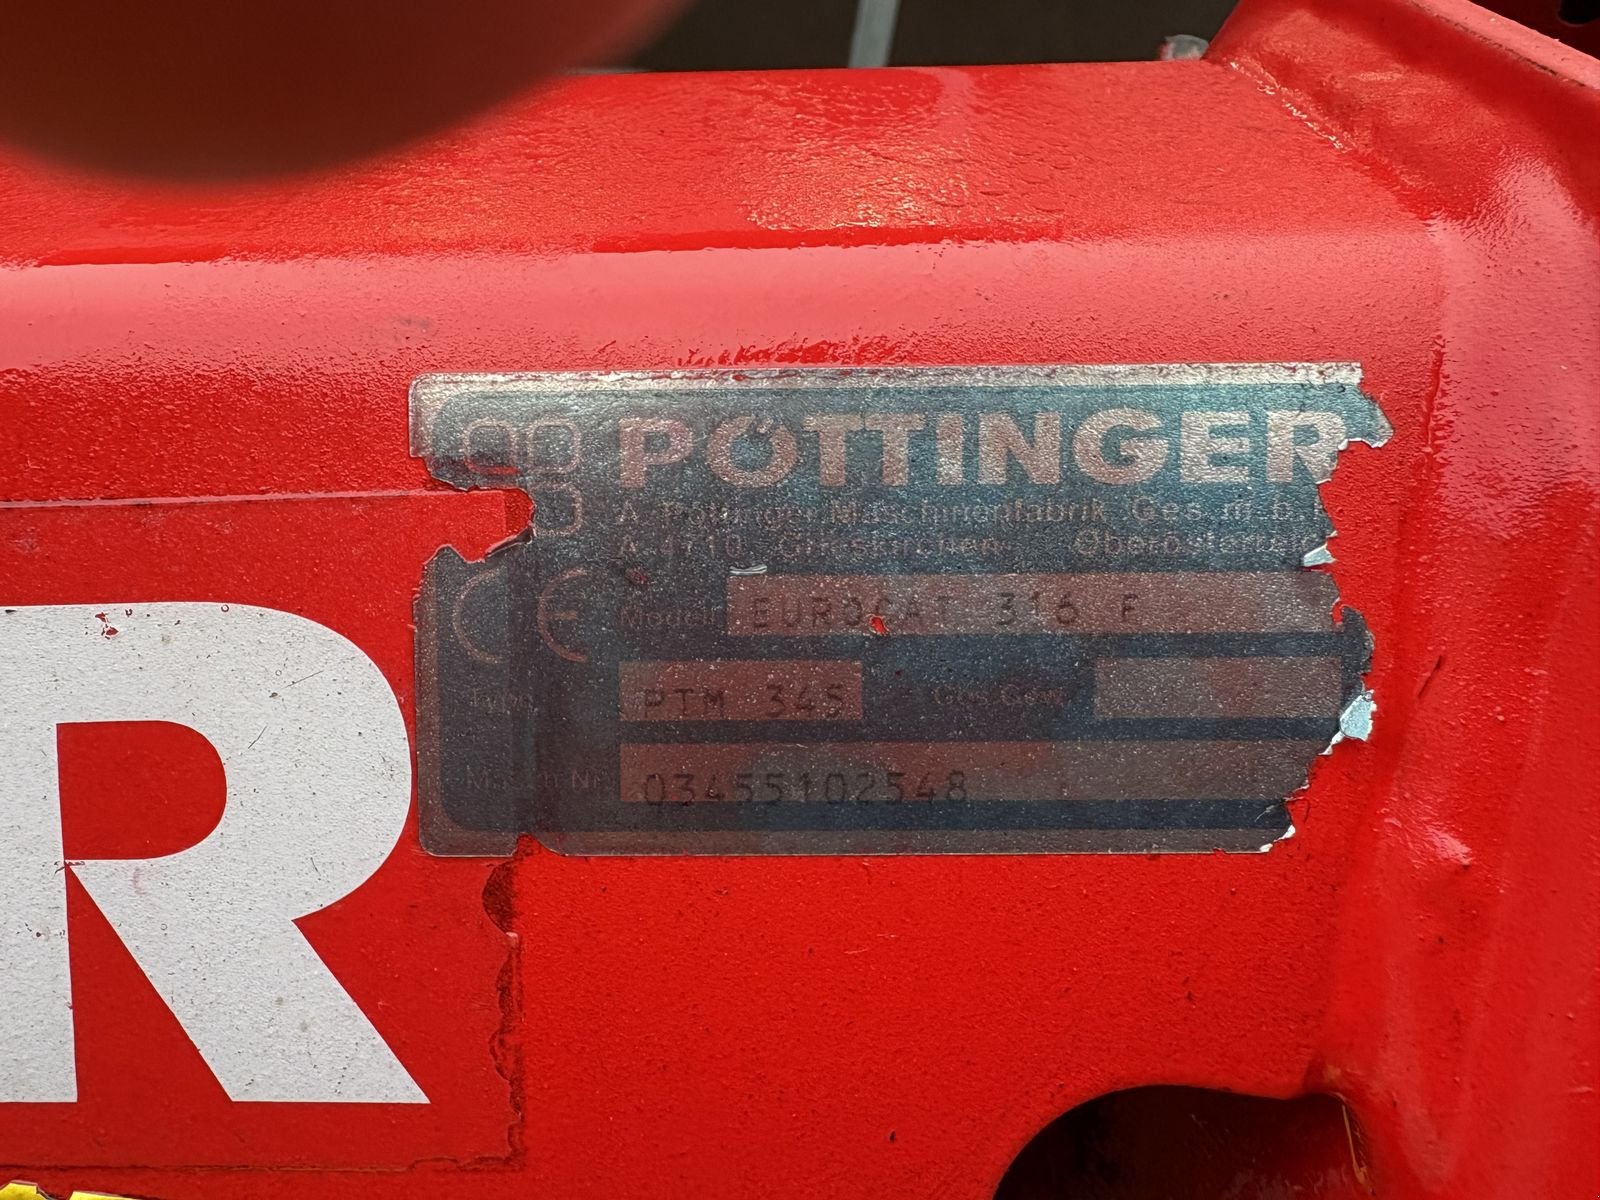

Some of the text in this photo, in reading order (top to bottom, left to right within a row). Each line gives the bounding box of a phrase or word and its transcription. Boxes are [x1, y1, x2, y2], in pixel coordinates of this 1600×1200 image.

[751, 591, 1139, 629] EUROCAT 316 F
[641, 684, 841, 720] PTM 345
[643, 770, 968, 808] 03455102548
